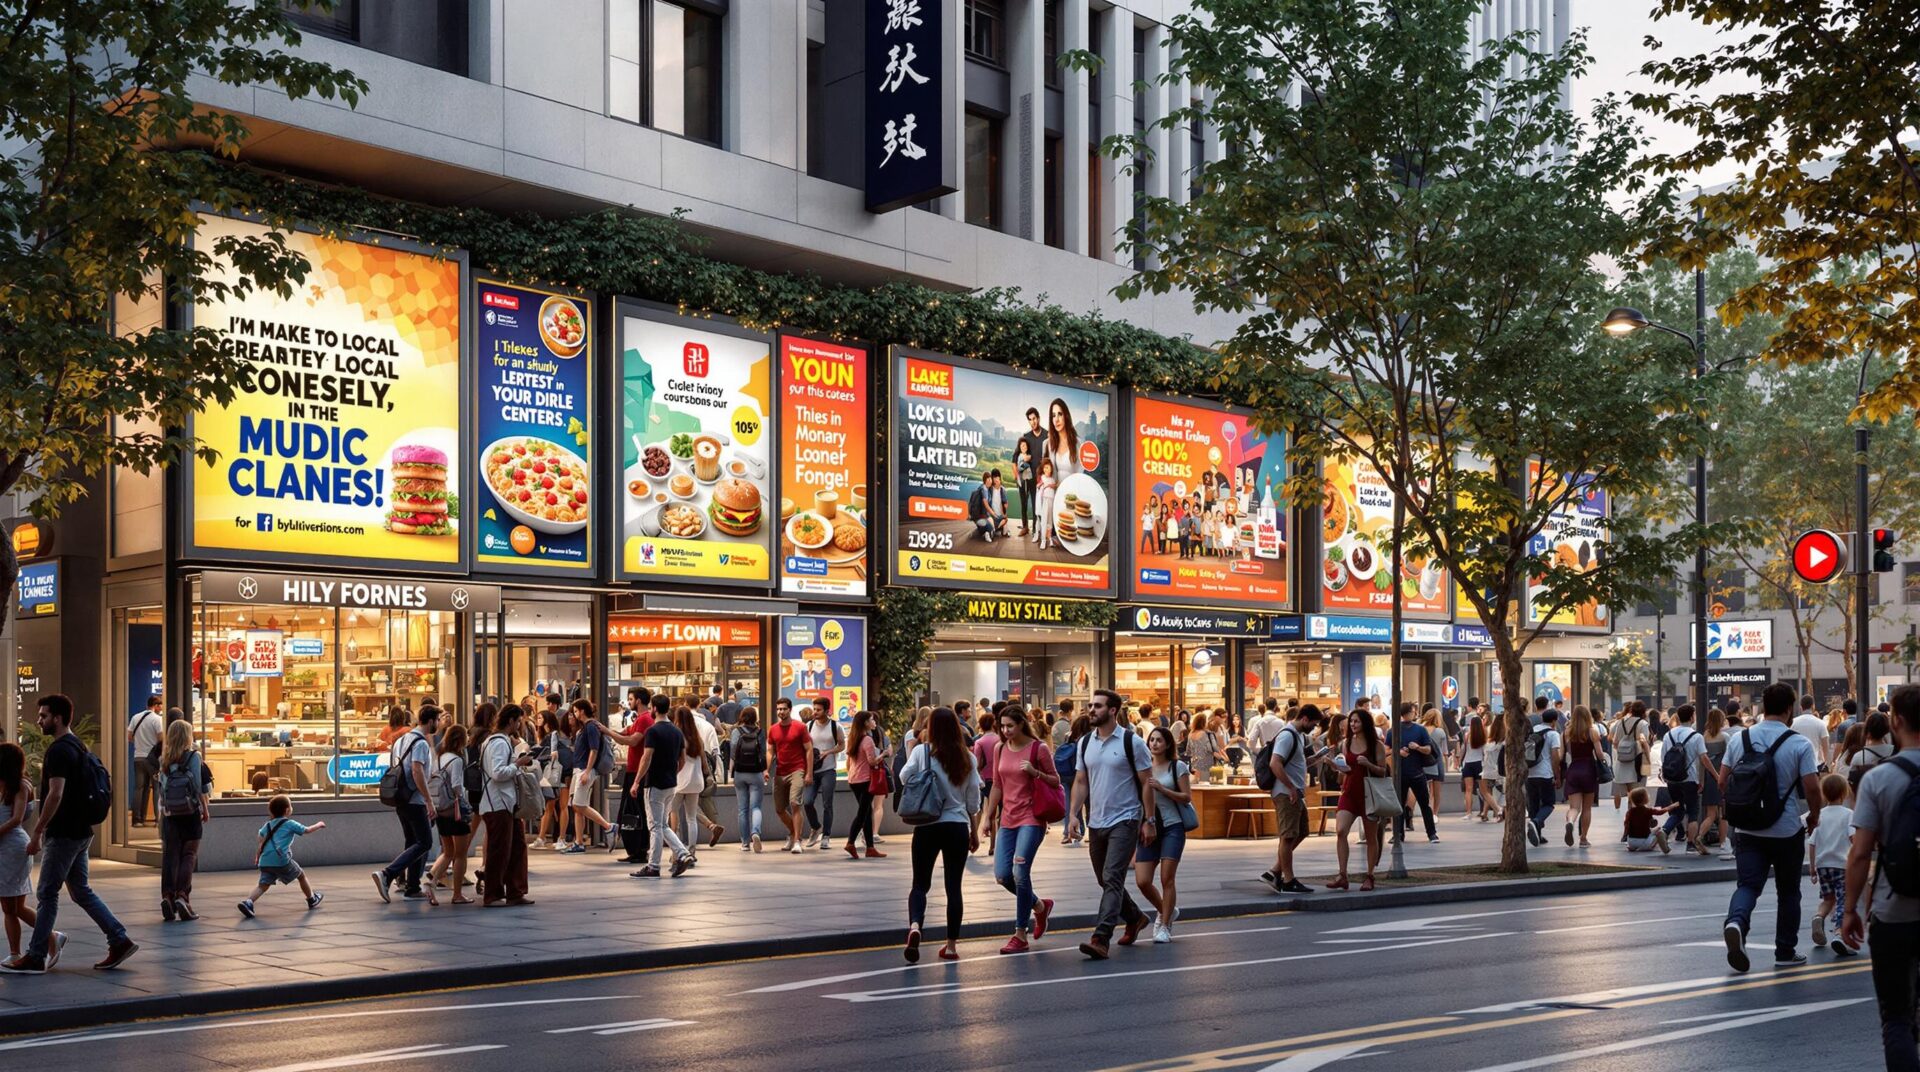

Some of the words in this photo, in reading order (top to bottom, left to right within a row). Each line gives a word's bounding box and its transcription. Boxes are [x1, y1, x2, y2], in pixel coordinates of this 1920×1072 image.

[230, 316, 254, 336] I'M
[260, 320, 310, 344] MAKE
[314, 328, 338, 348] TO
[342, 333, 400, 356] LOCAL
[335, 354, 400, 380] LOCAL
[494, 354, 508, 366] for
[512, 360, 524, 368] an
[789, 352, 854, 388] YOUN
[502, 370, 554, 390] LERTEST
[556, 382, 564, 390] in
[910, 366, 949, 387] LAKE
[492, 385, 532, 406] YOUR
[535, 391, 574, 410] DIRLE
[712, 400, 728, 408] our
[288, 402, 305, 418] IN
[310, 404, 338, 422] THE
[501, 405, 566, 427] CENTERS.
[830, 410, 842, 426] in
[947, 408, 966, 426] UP
[239, 415, 368, 466] MUDIC
[796, 424, 846, 448] Monary
[908, 422, 947, 444] YOUR
[950, 428, 982, 448] DINU
[1141, 437, 1188, 462] 100%
[796, 464, 849, 491] Fonge!
[1142, 460, 1192, 478] CRENERS
[228, 458, 384, 508] CLANES!
[235, 516, 252, 528] for
[282, 580, 336, 603] HILY
[340, 582, 428, 608] FORNES
[968, 600, 996, 618] MAY
[999, 602, 1022, 619] BLY
[1024, 602, 1062, 620] STALE
[662, 624, 720, 642] FLOWN
